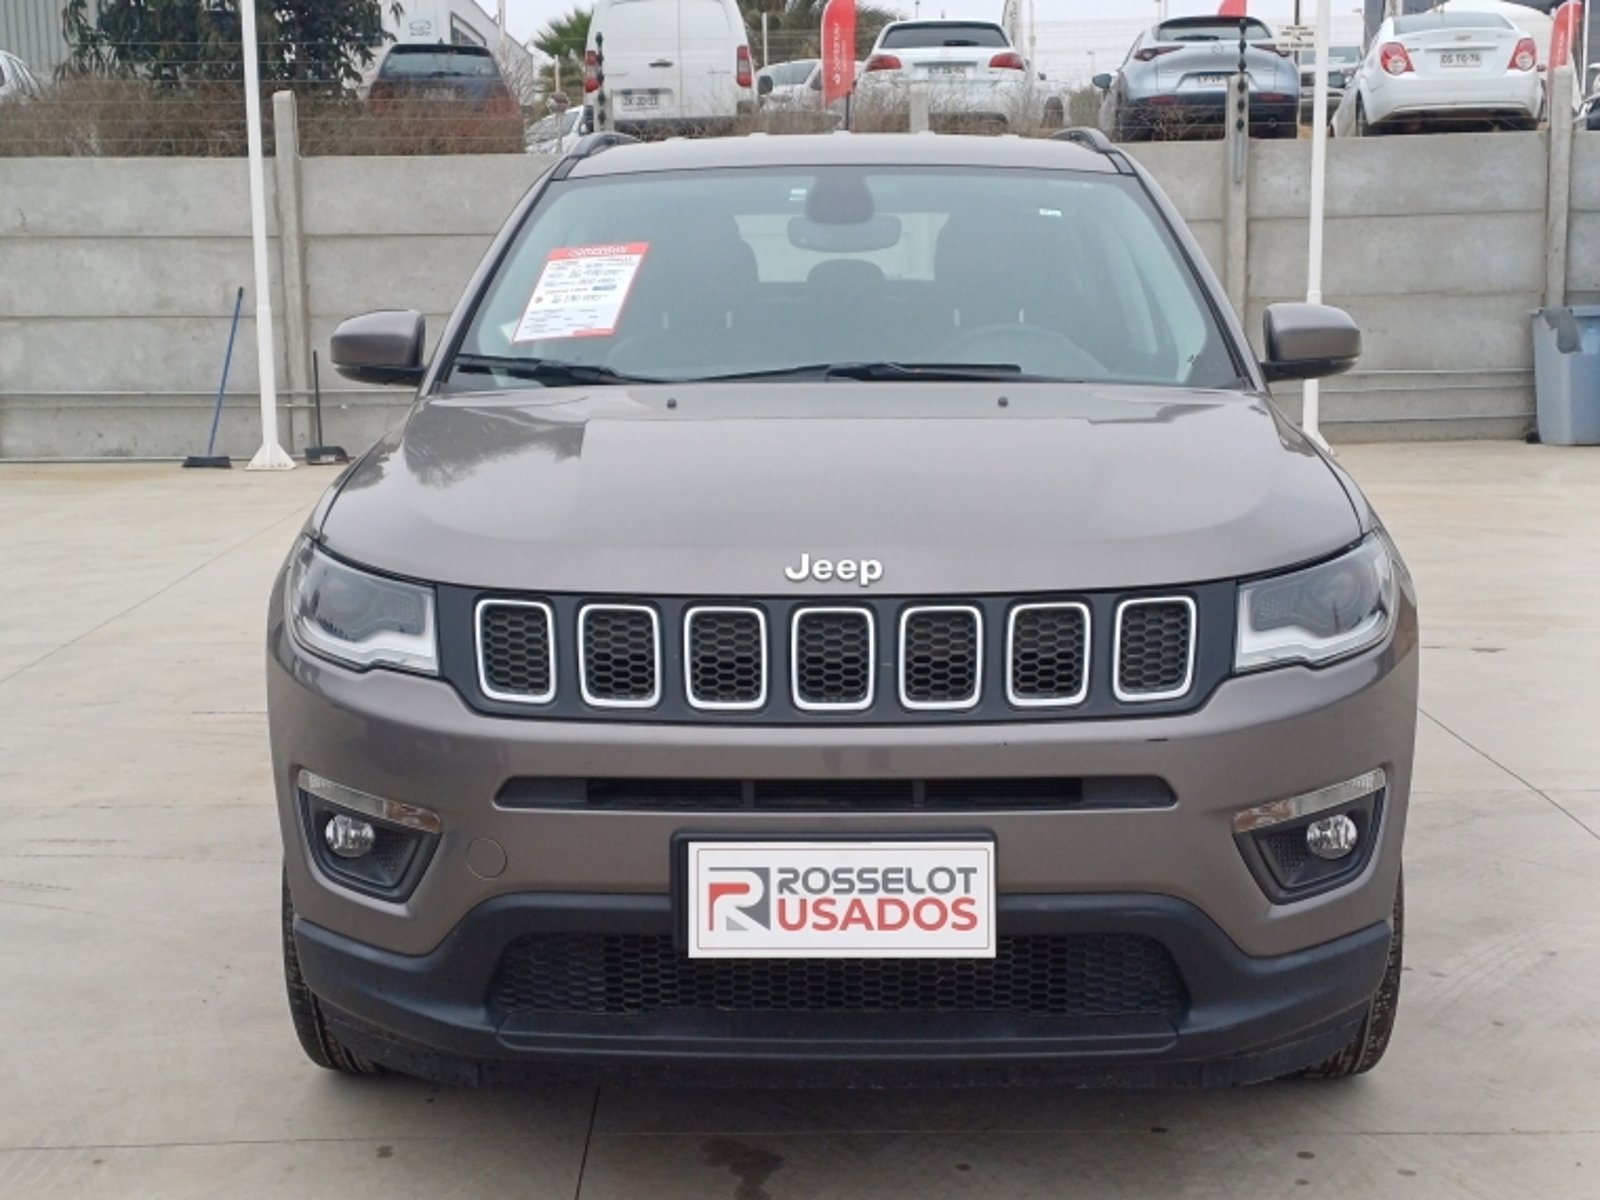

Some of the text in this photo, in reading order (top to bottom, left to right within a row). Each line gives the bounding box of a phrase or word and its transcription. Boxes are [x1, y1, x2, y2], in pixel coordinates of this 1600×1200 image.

[784, 552, 883, 587] Jeep
[777, 867, 978, 895] ROSSELOT
[777, 897, 978, 931] USADOS
